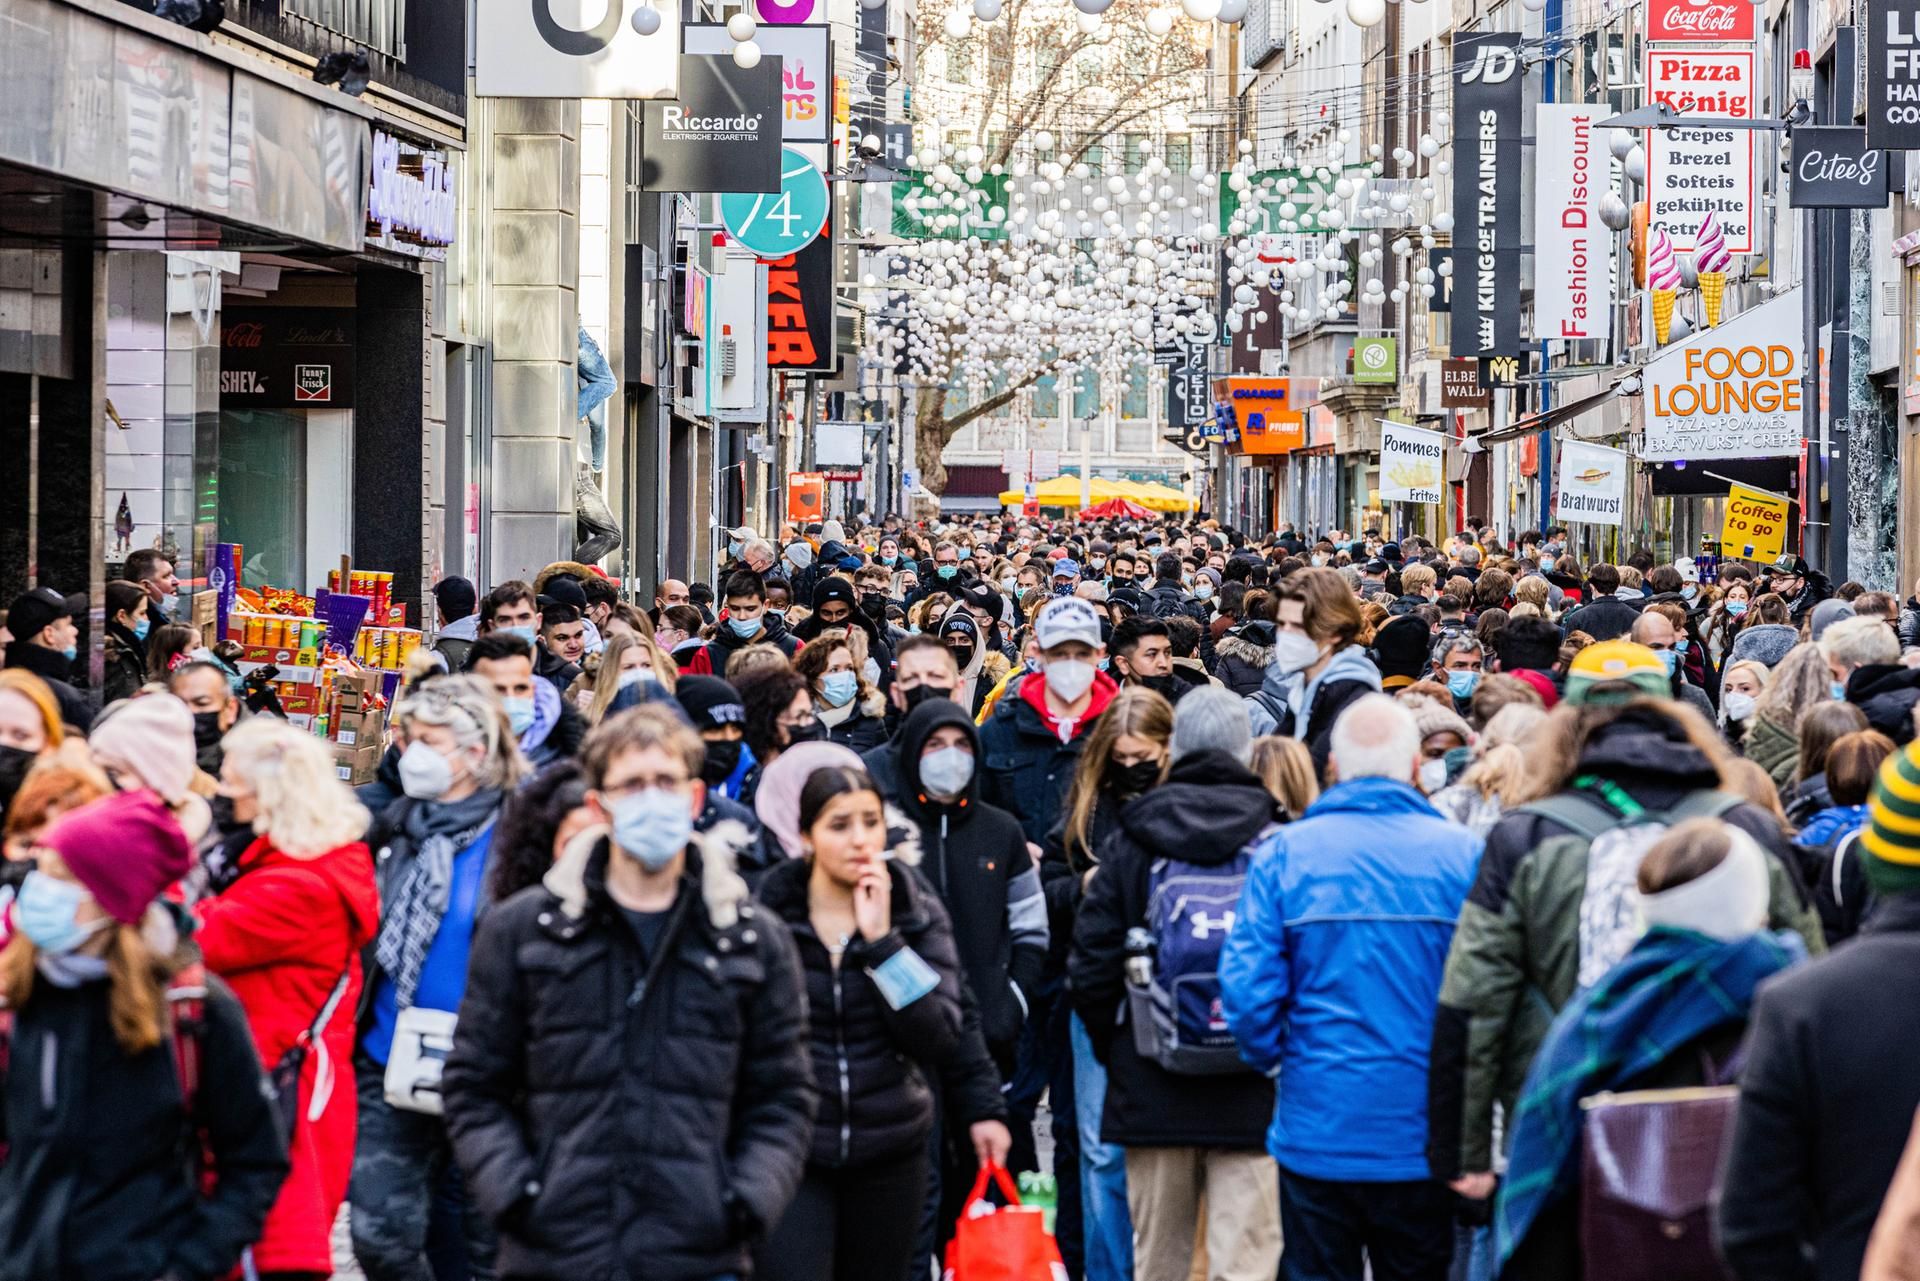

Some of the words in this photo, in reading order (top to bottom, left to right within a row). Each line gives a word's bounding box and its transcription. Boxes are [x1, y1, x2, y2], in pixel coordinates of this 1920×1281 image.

[1663, 5, 1738, 31] Coca-Cola
[1887, 11, 1920, 45] L
[1461, 46, 1516, 84] JD
[1660, 60, 1741, 81] Pizza
[1887, 84, 1920, 101] HA
[1654, 91, 1747, 117] König
[1887, 106, 1920, 124] CO
[662, 133, 711, 141] ELEKTRISCHE
[1667, 128, 1734, 145] Crepes
[1478, 109, 1498, 227] TRAINERS
[1669, 151, 1731, 165] Brezel
[1561, 115, 1590, 229] Discount
[1666, 175, 1734, 188] Softeis
[1656, 198, 1743, 215] gekühlte
[1653, 221, 1746, 236] Getrke
[1478, 229, 1496, 252] OF
[1478, 255, 1495, 311] KING
[1561, 239, 1588, 338] Fashion
[1685, 345, 1795, 381] FOOD
[1444, 371, 1476, 383] ELBE
[1232, 389, 1286, 400] CHANGE
[1446, 385, 1486, 397] WALD
[1654, 379, 1801, 417] LOUNGE
[1665, 417, 1709, 433] PIZZA
[1719, 414, 1788, 431] POMMES
[1383, 434, 1440, 458] Pommes
[1651, 435, 1743, 453] BRATWURST
[1409, 488, 1440, 503] Frites
[1561, 491, 1620, 514] Bratwurst
[1730, 501, 1782, 523] Coffee
[1729, 517, 1747, 531] to
[1752, 523, 1773, 537] go
